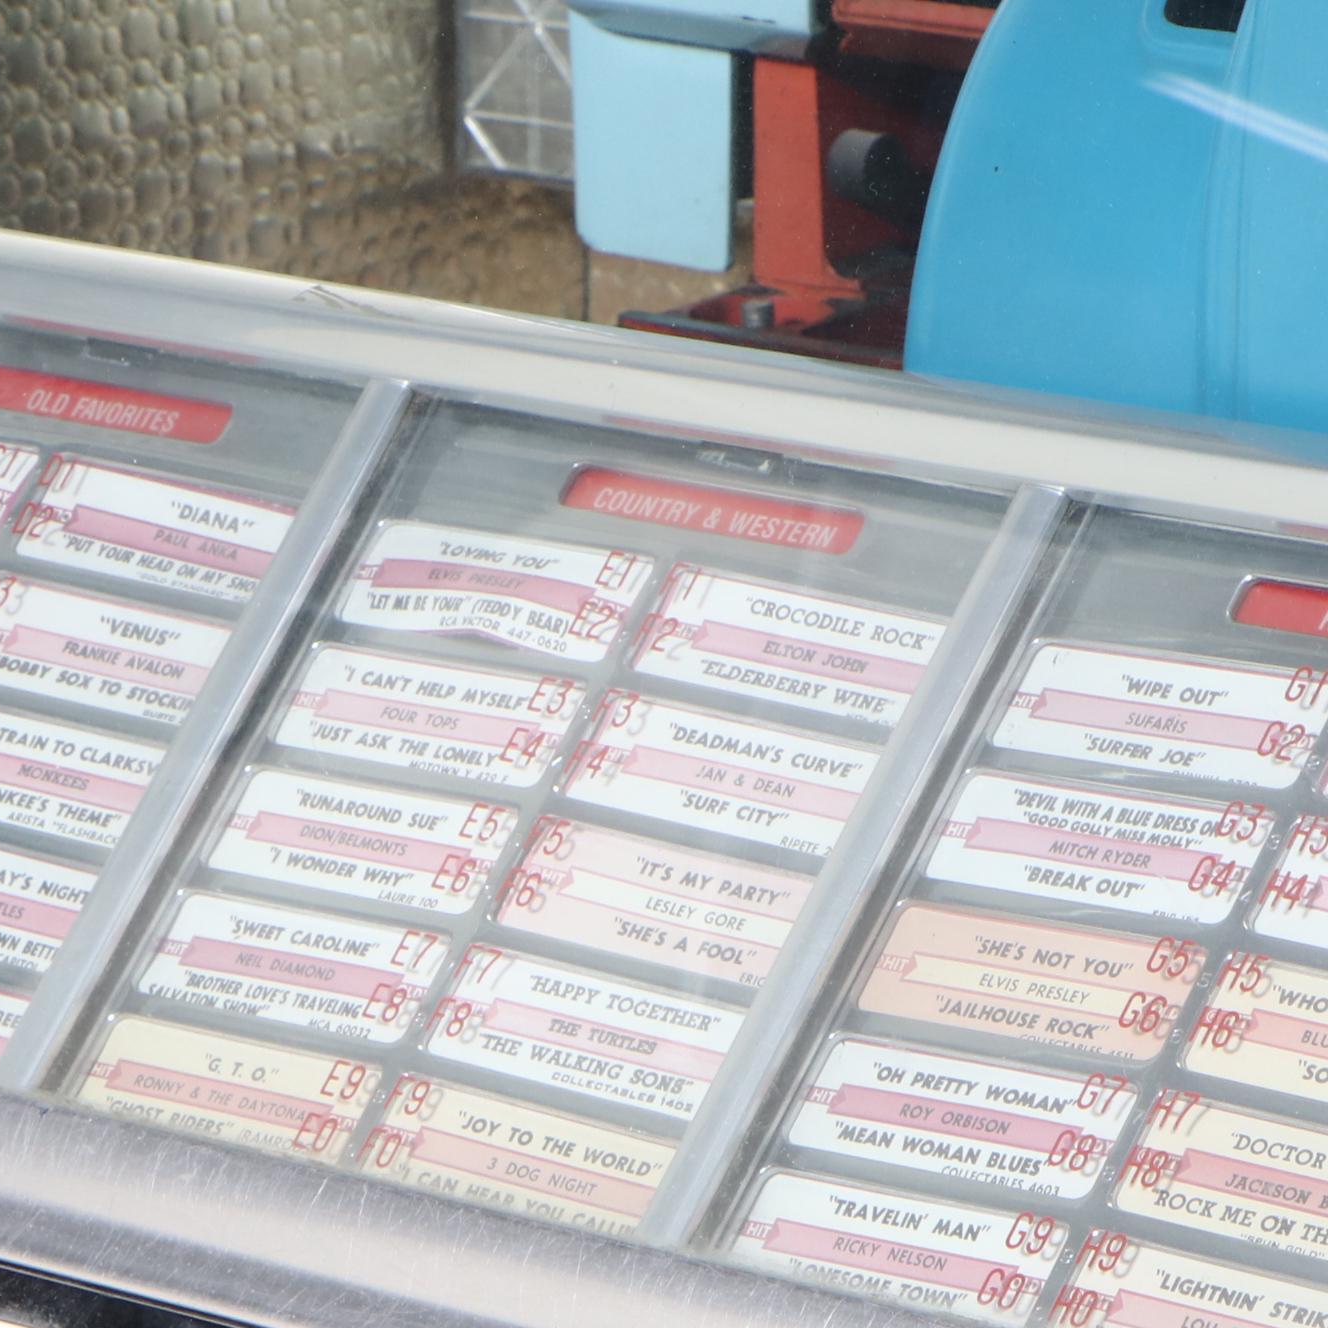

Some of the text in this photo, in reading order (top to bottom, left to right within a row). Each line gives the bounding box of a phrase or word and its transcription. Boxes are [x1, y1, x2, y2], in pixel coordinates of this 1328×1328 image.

[27, 389, 179, 433] OLD FAVORITES
[593, 487, 700, 523] COUNTRY
[729, 511, 838, 547] WESTERN
